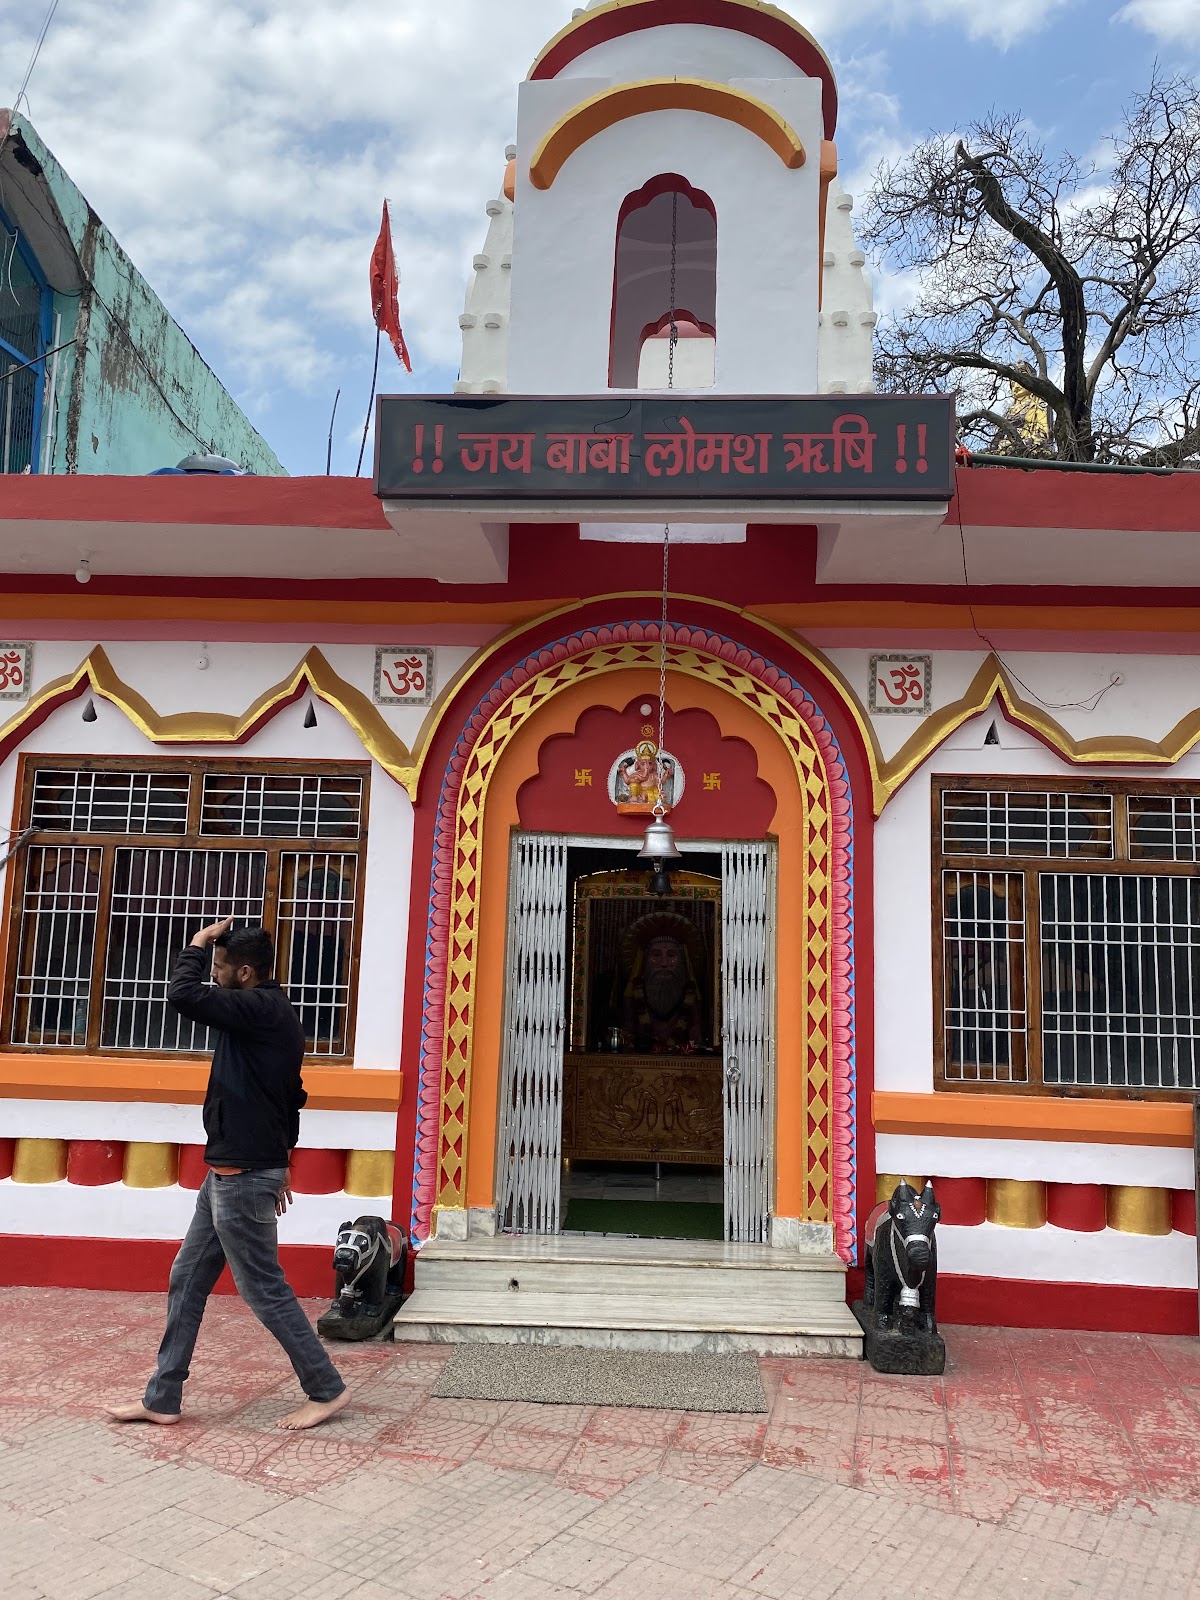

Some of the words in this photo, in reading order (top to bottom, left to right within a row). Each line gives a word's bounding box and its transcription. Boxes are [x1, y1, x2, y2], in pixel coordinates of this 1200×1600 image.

[458, 432, 535, 473] जय
[546, 432, 633, 473] बाबा
[645, 416, 772, 477] लोमश
[783, 414, 877, 473] ऋषि
[382, 655, 425, 695] ॐ
[878, 664, 923, 705] ॐ
